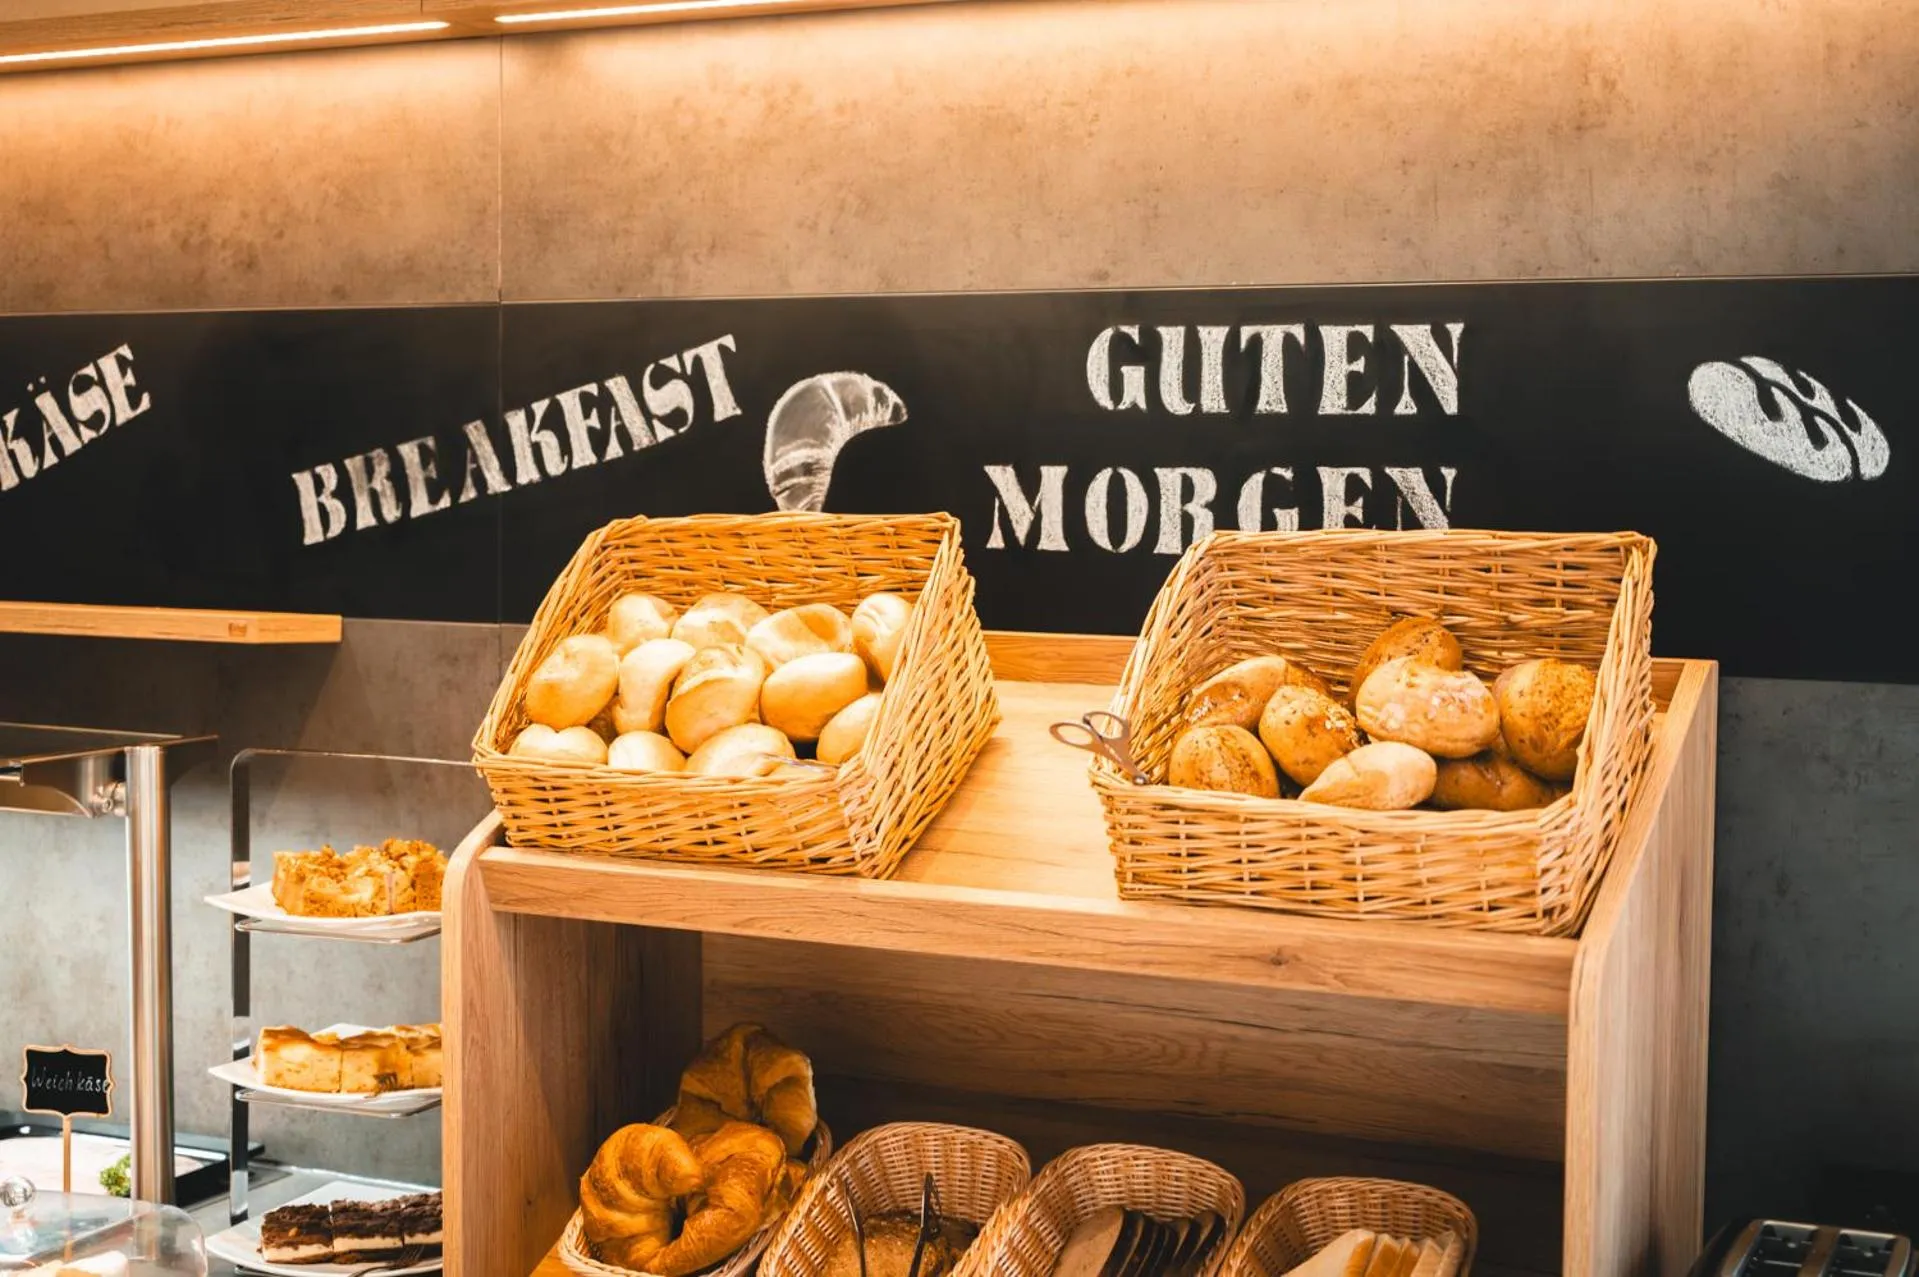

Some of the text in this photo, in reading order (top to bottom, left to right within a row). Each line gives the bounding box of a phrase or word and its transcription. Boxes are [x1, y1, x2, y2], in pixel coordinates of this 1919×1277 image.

[0, 343, 151, 491] KÄSE
[1086, 323, 1465, 415] GUTEN
[292, 334, 742, 546] BREAKFAST
[984, 465, 1457, 554] MORGEN
